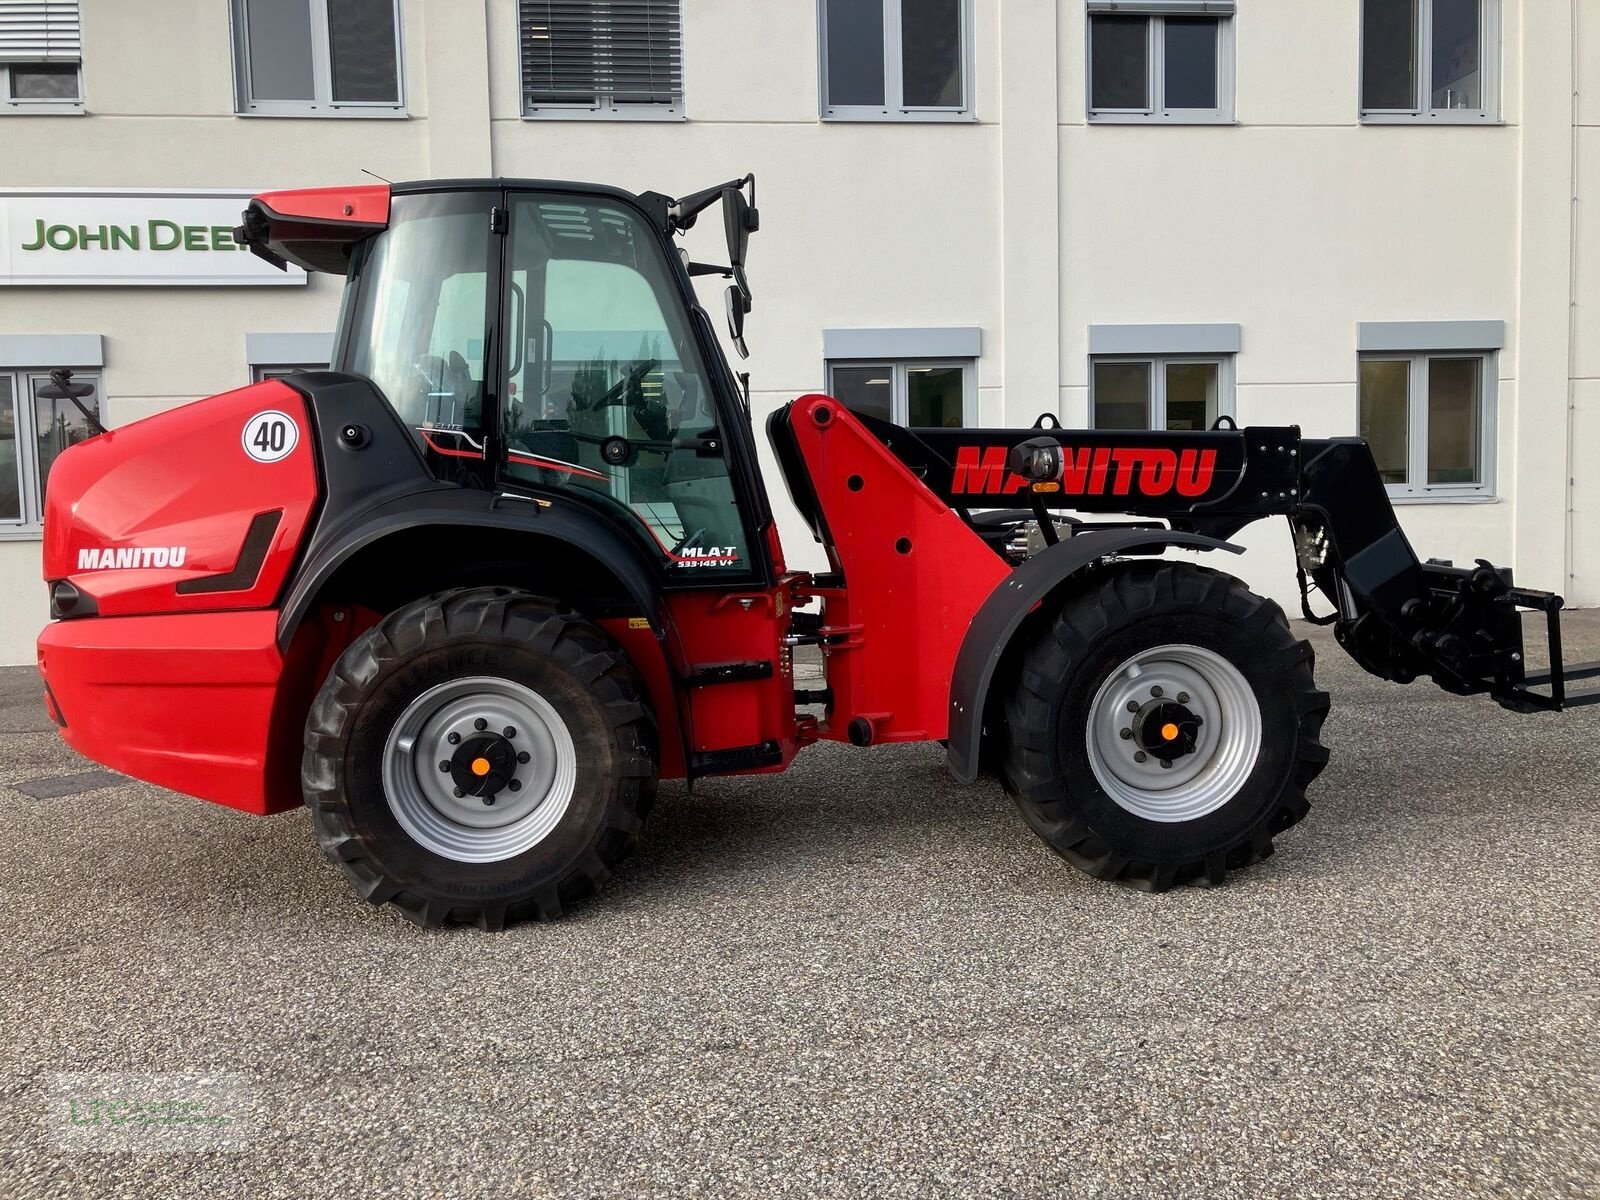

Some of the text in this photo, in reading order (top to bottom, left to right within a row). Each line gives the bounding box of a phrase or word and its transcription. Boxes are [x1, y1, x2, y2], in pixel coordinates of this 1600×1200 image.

[21, 218, 247, 251] JOHN DEE
[253, 420, 286, 452] 40
[77, 546, 186, 569] MANITOU
[681, 546, 737, 558] MLA-T
[719, 559, 733, 567] V+
